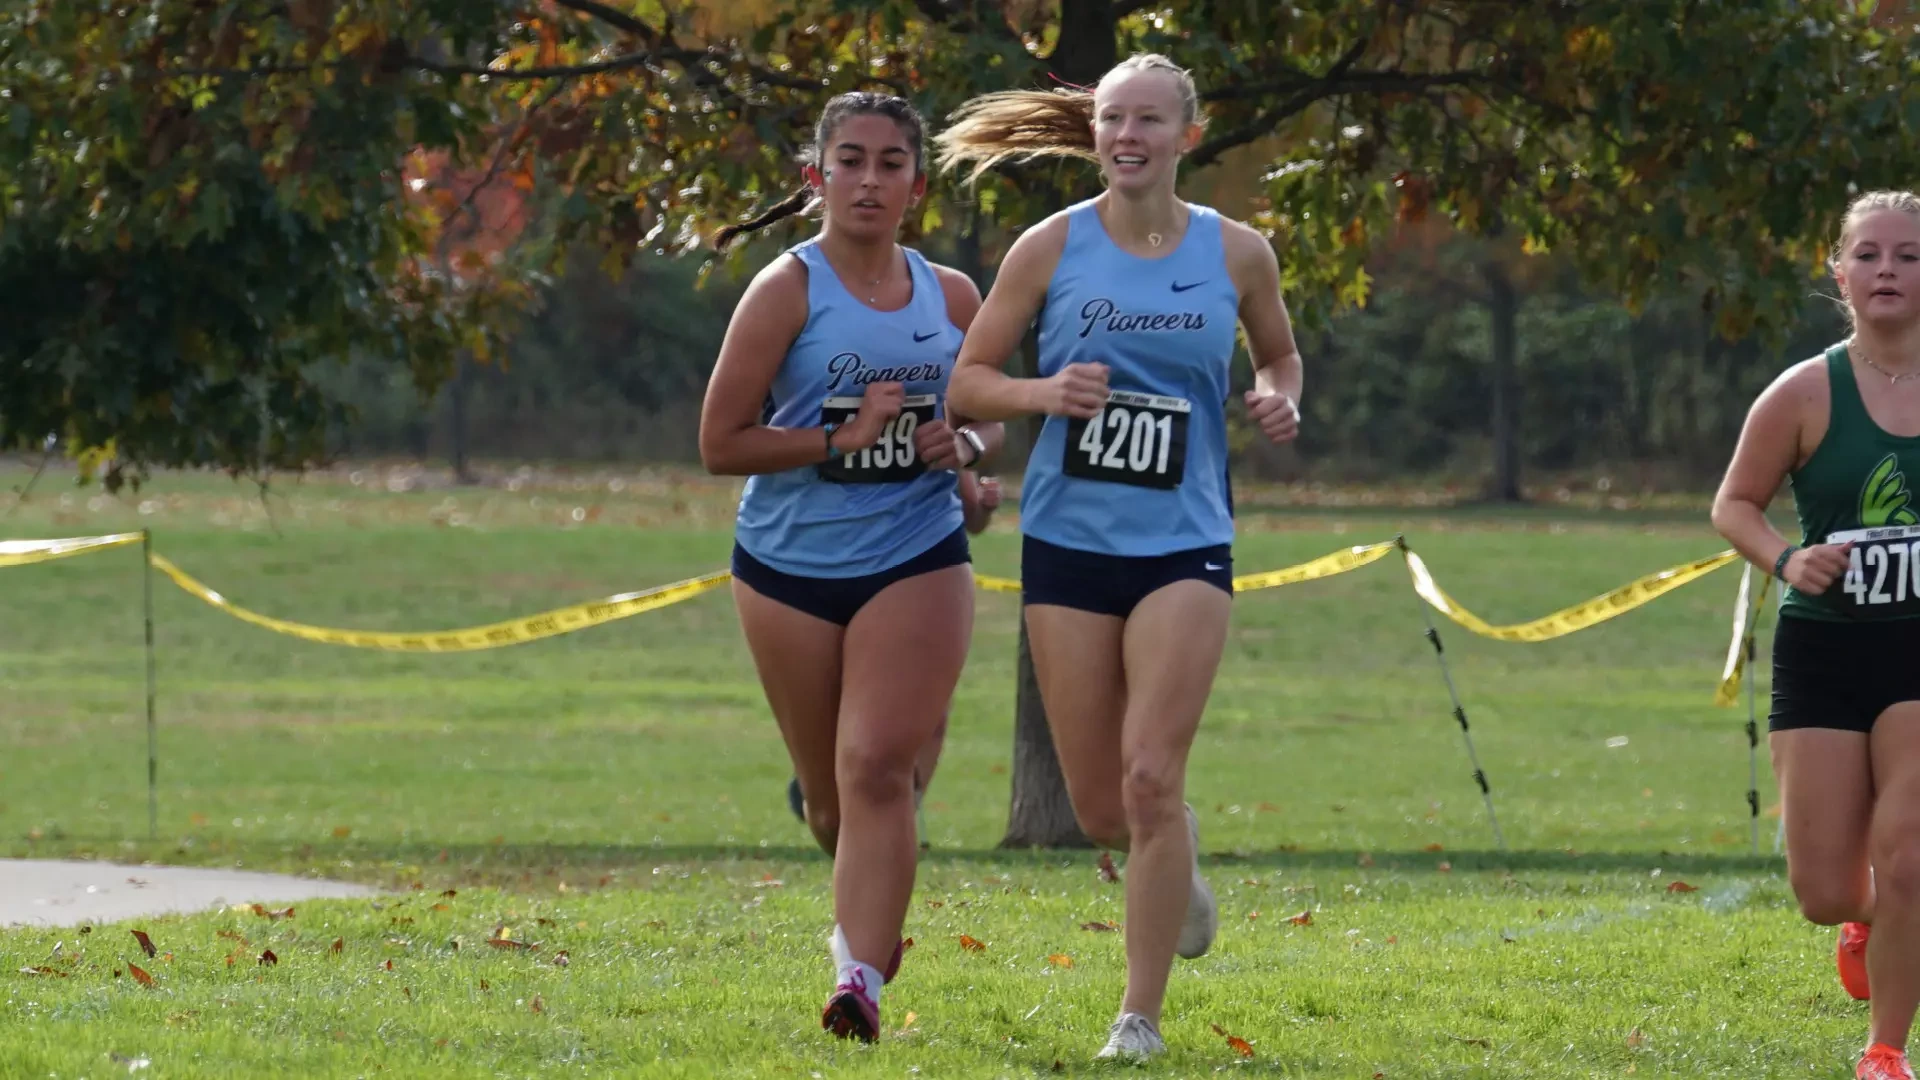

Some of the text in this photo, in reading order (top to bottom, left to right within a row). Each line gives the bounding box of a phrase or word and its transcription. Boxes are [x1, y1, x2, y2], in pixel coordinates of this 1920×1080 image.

[1079, 298, 1208, 338] Pioneers
[826, 352, 944, 391] Pioneers
[1079, 407, 1172, 474] 4201
